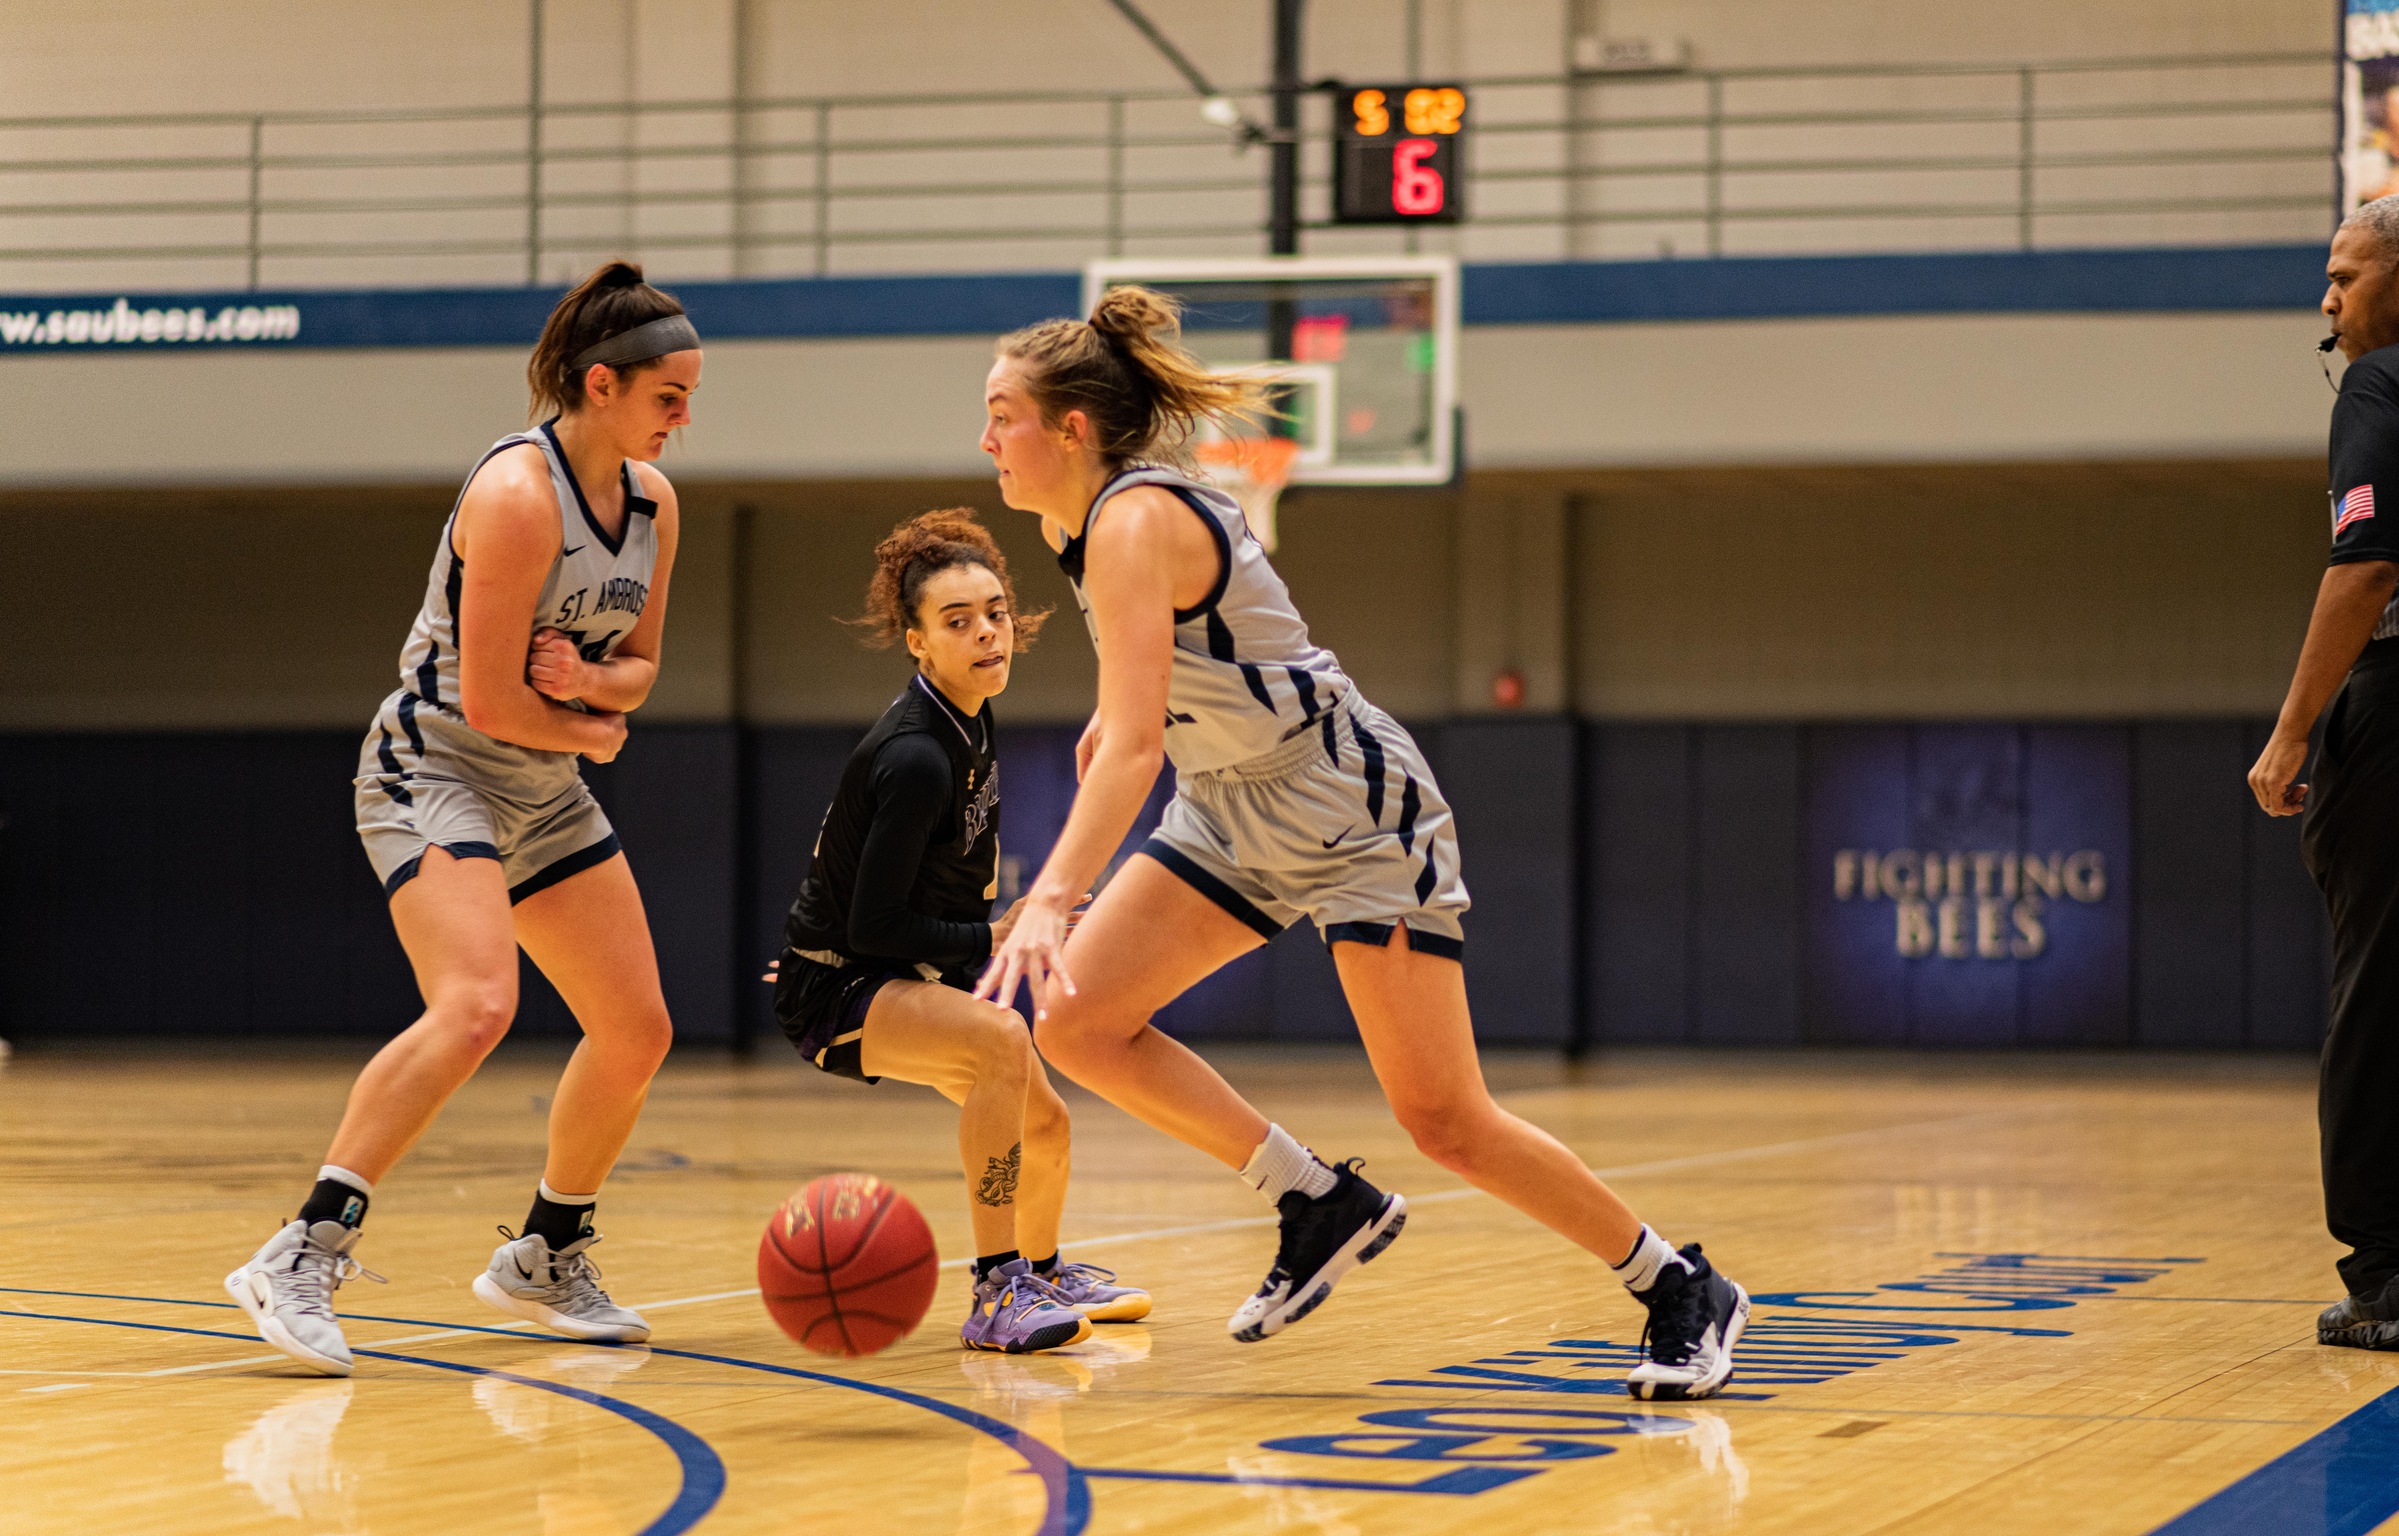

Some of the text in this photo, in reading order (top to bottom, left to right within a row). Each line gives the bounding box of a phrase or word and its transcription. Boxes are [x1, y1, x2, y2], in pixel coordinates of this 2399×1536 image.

[1392, 138, 1444, 215] 6
[555, 577, 648, 624] ST. AMBROS
[1833, 849, 2107, 902] FIGHTING
[1895, 896, 2047, 959] BEES
